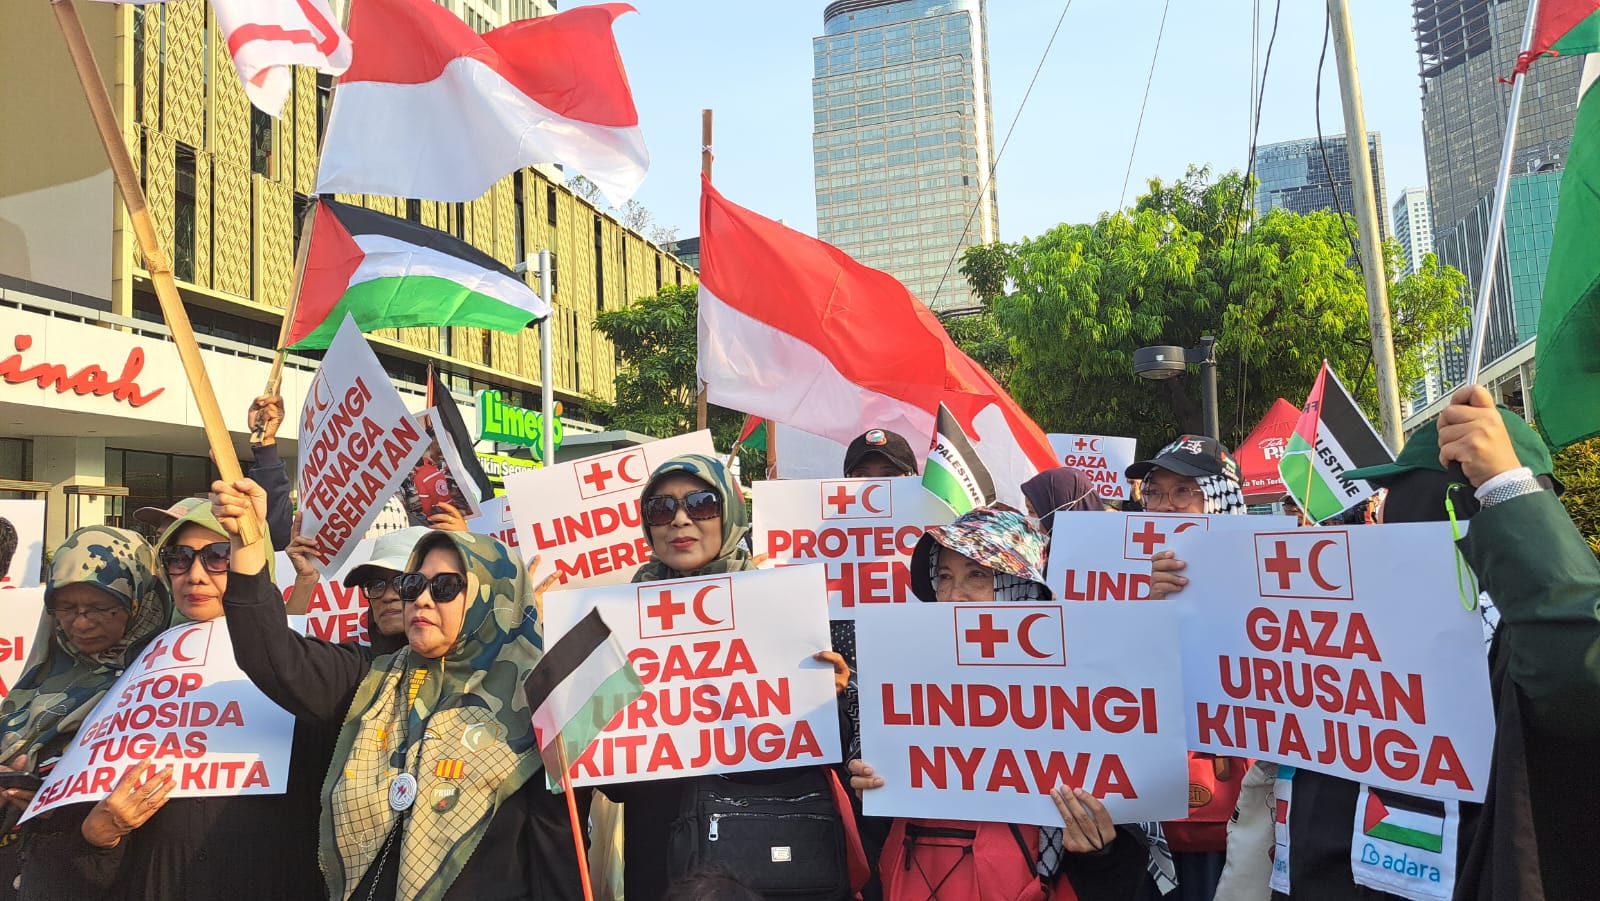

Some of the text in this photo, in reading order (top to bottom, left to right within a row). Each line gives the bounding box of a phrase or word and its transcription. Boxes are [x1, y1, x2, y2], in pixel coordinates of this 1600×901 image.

[299, 376, 373, 501] LINDUNGI
[1064, 454, 1108, 470] GAZA
[305, 416, 385, 520] TENAGA
[314, 415, 420, 566] KESEHATAN
[934, 442, 981, 506] PALESTINE
[1083, 469, 1118, 484] SAN
[532, 498, 642, 551] LINDU
[767, 525, 940, 560] PROTEC
[554, 537, 653, 585] MERE
[1064, 568, 1153, 601] LIND
[1246, 606, 1382, 662] GAZA
[624, 638, 758, 686] GAZA
[117, 672, 203, 708] STOP
[592, 677, 792, 733] URUSAN
[881, 683, 1158, 734] LINDUNGI
[1218, 655, 1426, 725] URUSAN
[80, 700, 245, 747] GENOSIDA
[87, 731, 208, 766] TUGAS
[567, 719, 824, 779] KITA JUGA
[1196, 702, 1474, 791] KITA JUGA
[180, 761, 271, 790] KITA
[908, 745, 1138, 799] NYAWA
[1382, 852, 1441, 883] adara
